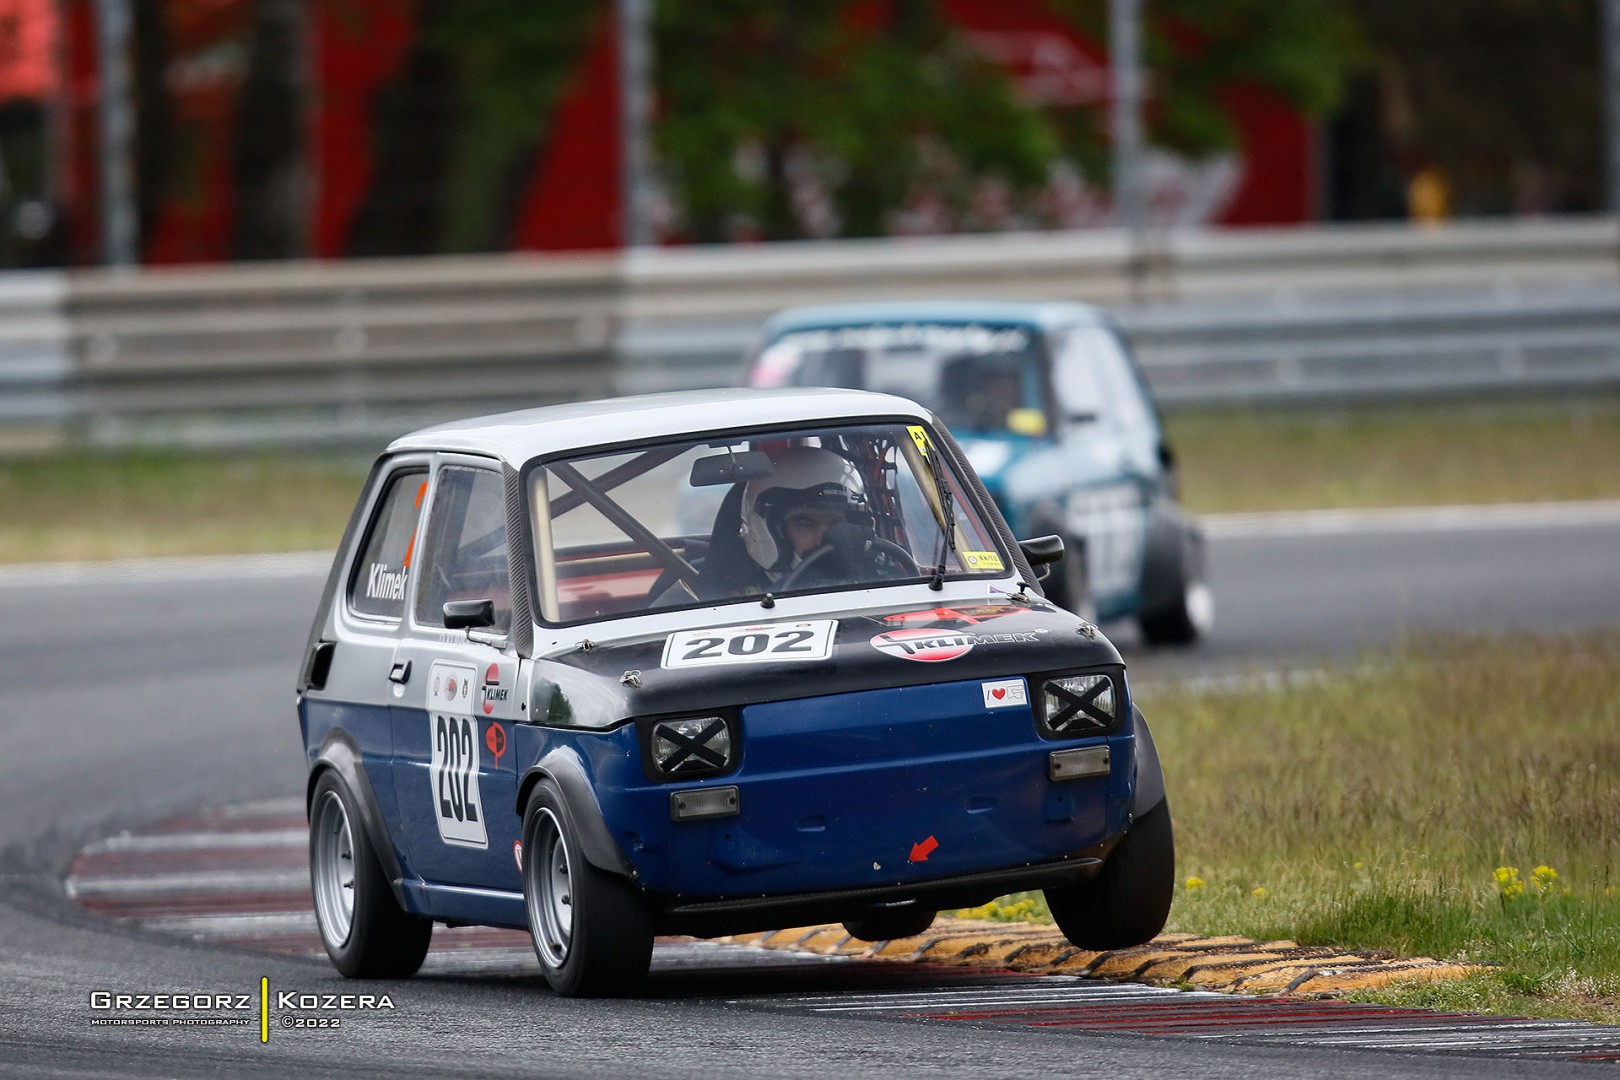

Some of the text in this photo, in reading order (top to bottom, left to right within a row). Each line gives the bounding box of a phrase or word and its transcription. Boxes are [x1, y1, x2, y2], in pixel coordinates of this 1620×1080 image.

[366, 563, 408, 600] Klimek
[681, 630, 815, 661] 202
[911, 631, 1041, 650] KLIMEK
[485, 687, 509, 701] KLIMEK
[437, 715, 479, 823] 202
